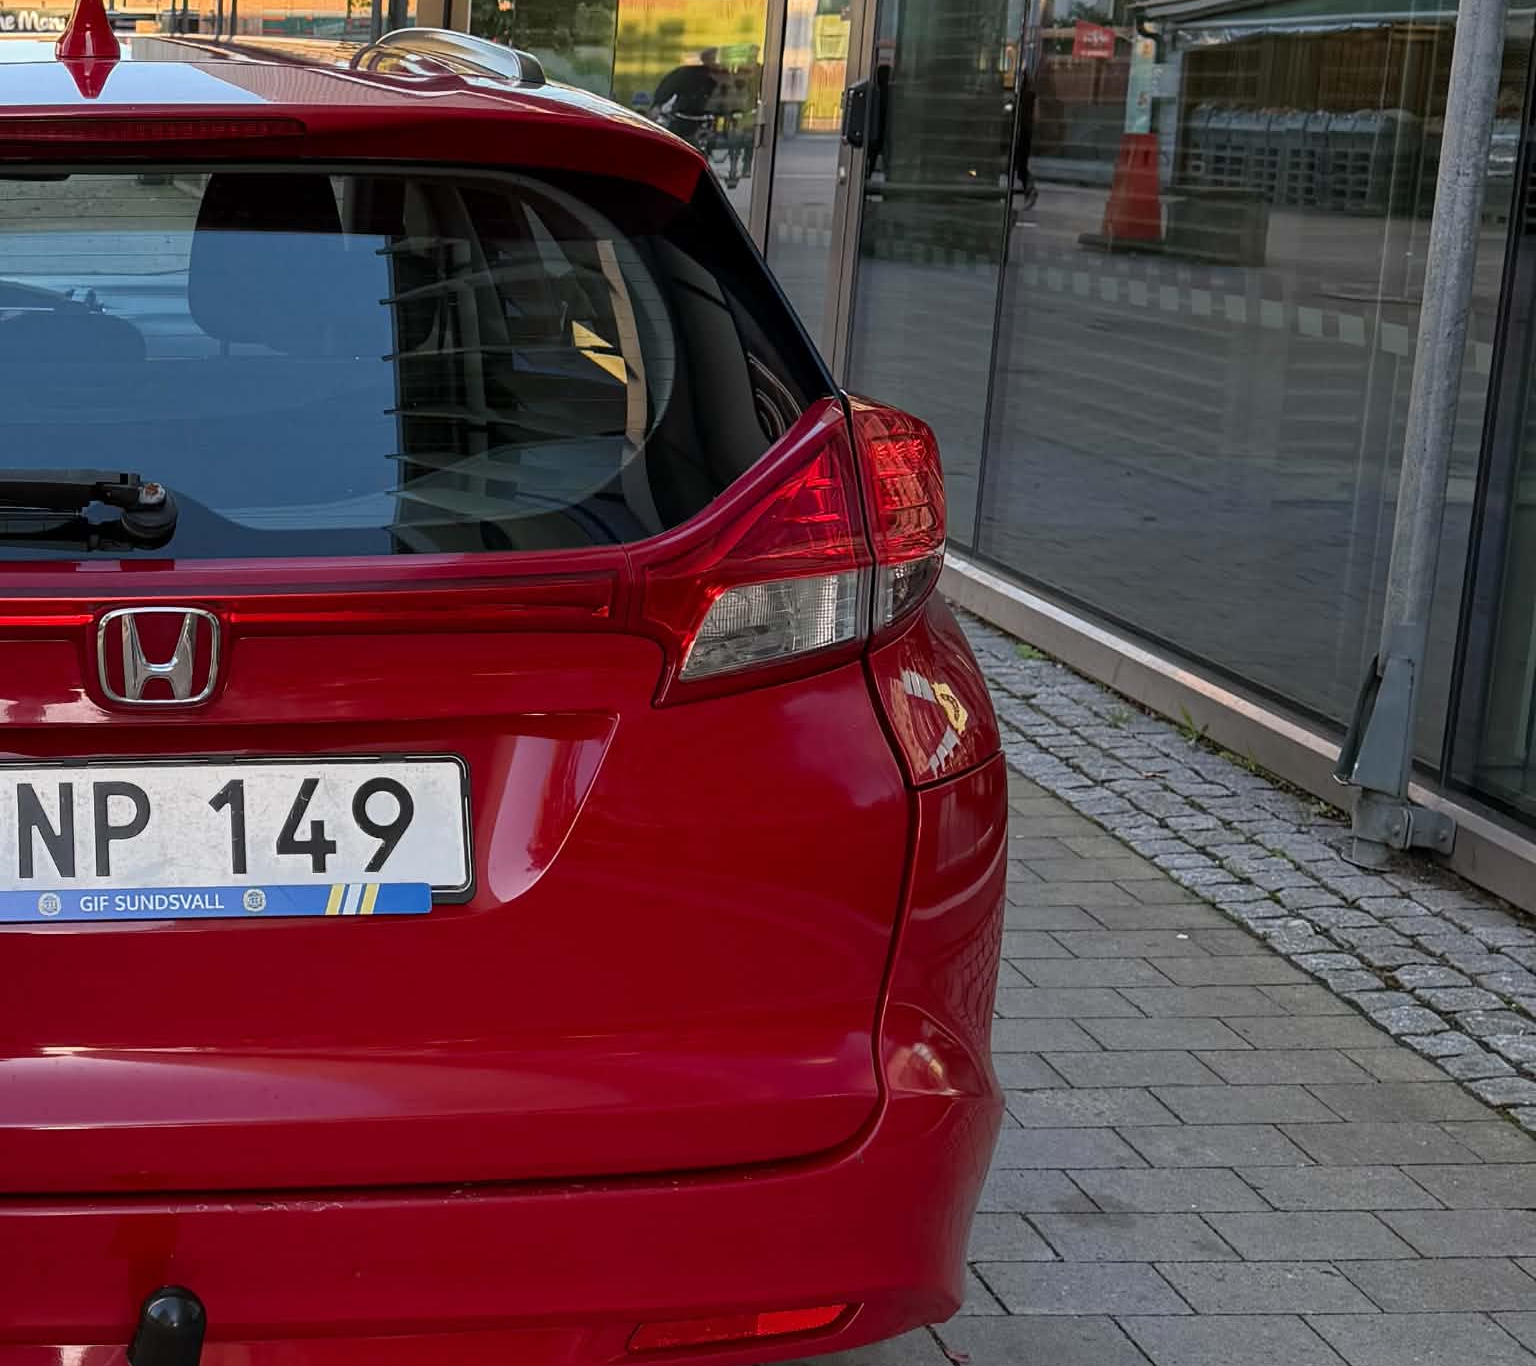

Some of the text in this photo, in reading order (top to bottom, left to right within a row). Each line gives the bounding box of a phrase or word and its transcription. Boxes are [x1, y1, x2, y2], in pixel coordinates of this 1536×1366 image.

[208, 776, 415, 875] 149
[79, 893, 225, 912] GIF SUNDSVALL
